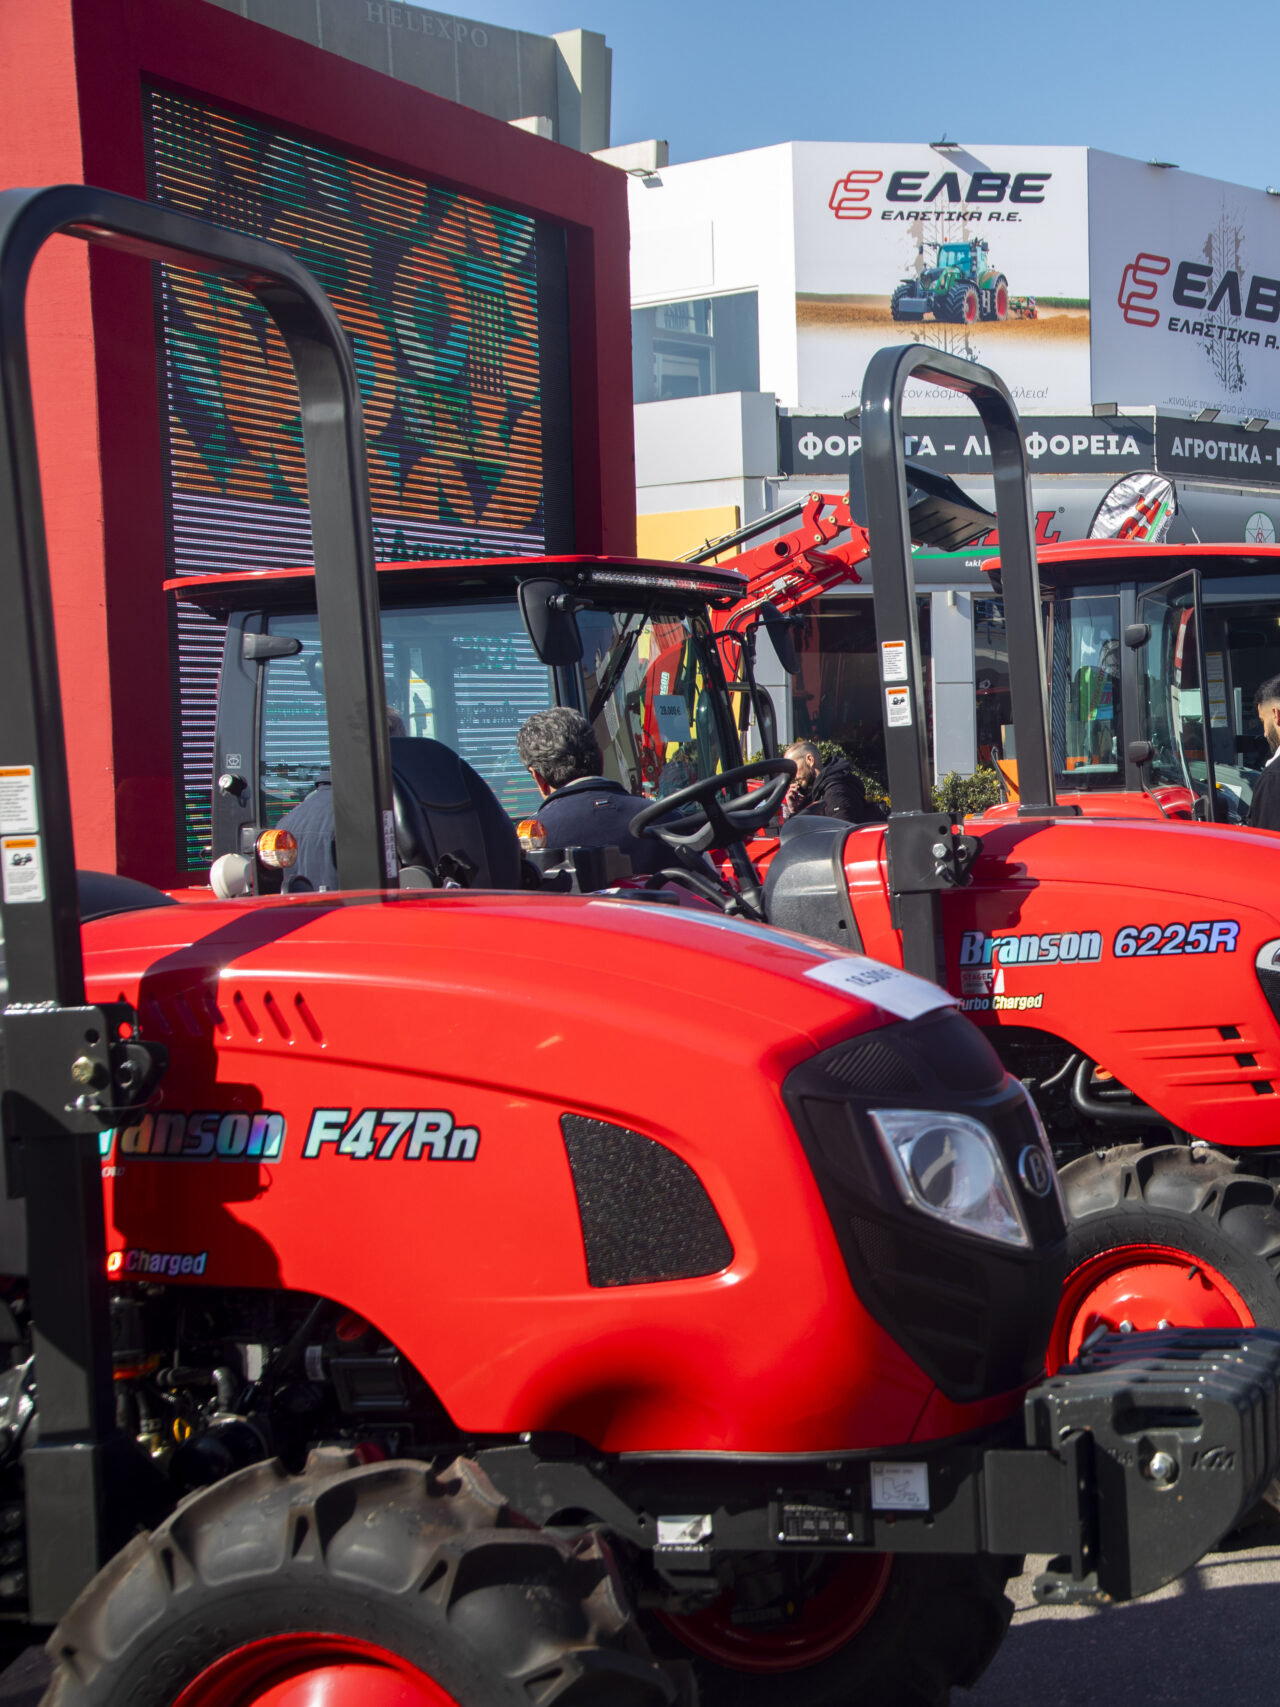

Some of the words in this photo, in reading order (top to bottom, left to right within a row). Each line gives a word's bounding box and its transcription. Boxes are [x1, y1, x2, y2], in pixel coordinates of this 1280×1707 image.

[367, 1, 488, 49] HELEXPO
[886, 170, 1052, 204] ΕΛΒΕ
[881, 210, 983, 222] ΕΛΑΣΤΙΚΑ
[1167, 316, 1260, 346] ΕΛΑΣΤΙΚΑ
[798, 431, 937, 460] ΦΟΡΓΑ
[963, 431, 1141, 460] ΛΦΟΡΕΙΑ
[1171, 436, 1262, 465] ΑΓΡΟΤΙΚΑ
[959, 930, 1103, 967] Branson
[1114, 919, 1240, 958] 6225R
[991, 993, 1044, 1011] Charged
[302, 1107, 480, 1161] F47Rn
[125, 1249, 208, 1277] Charged
